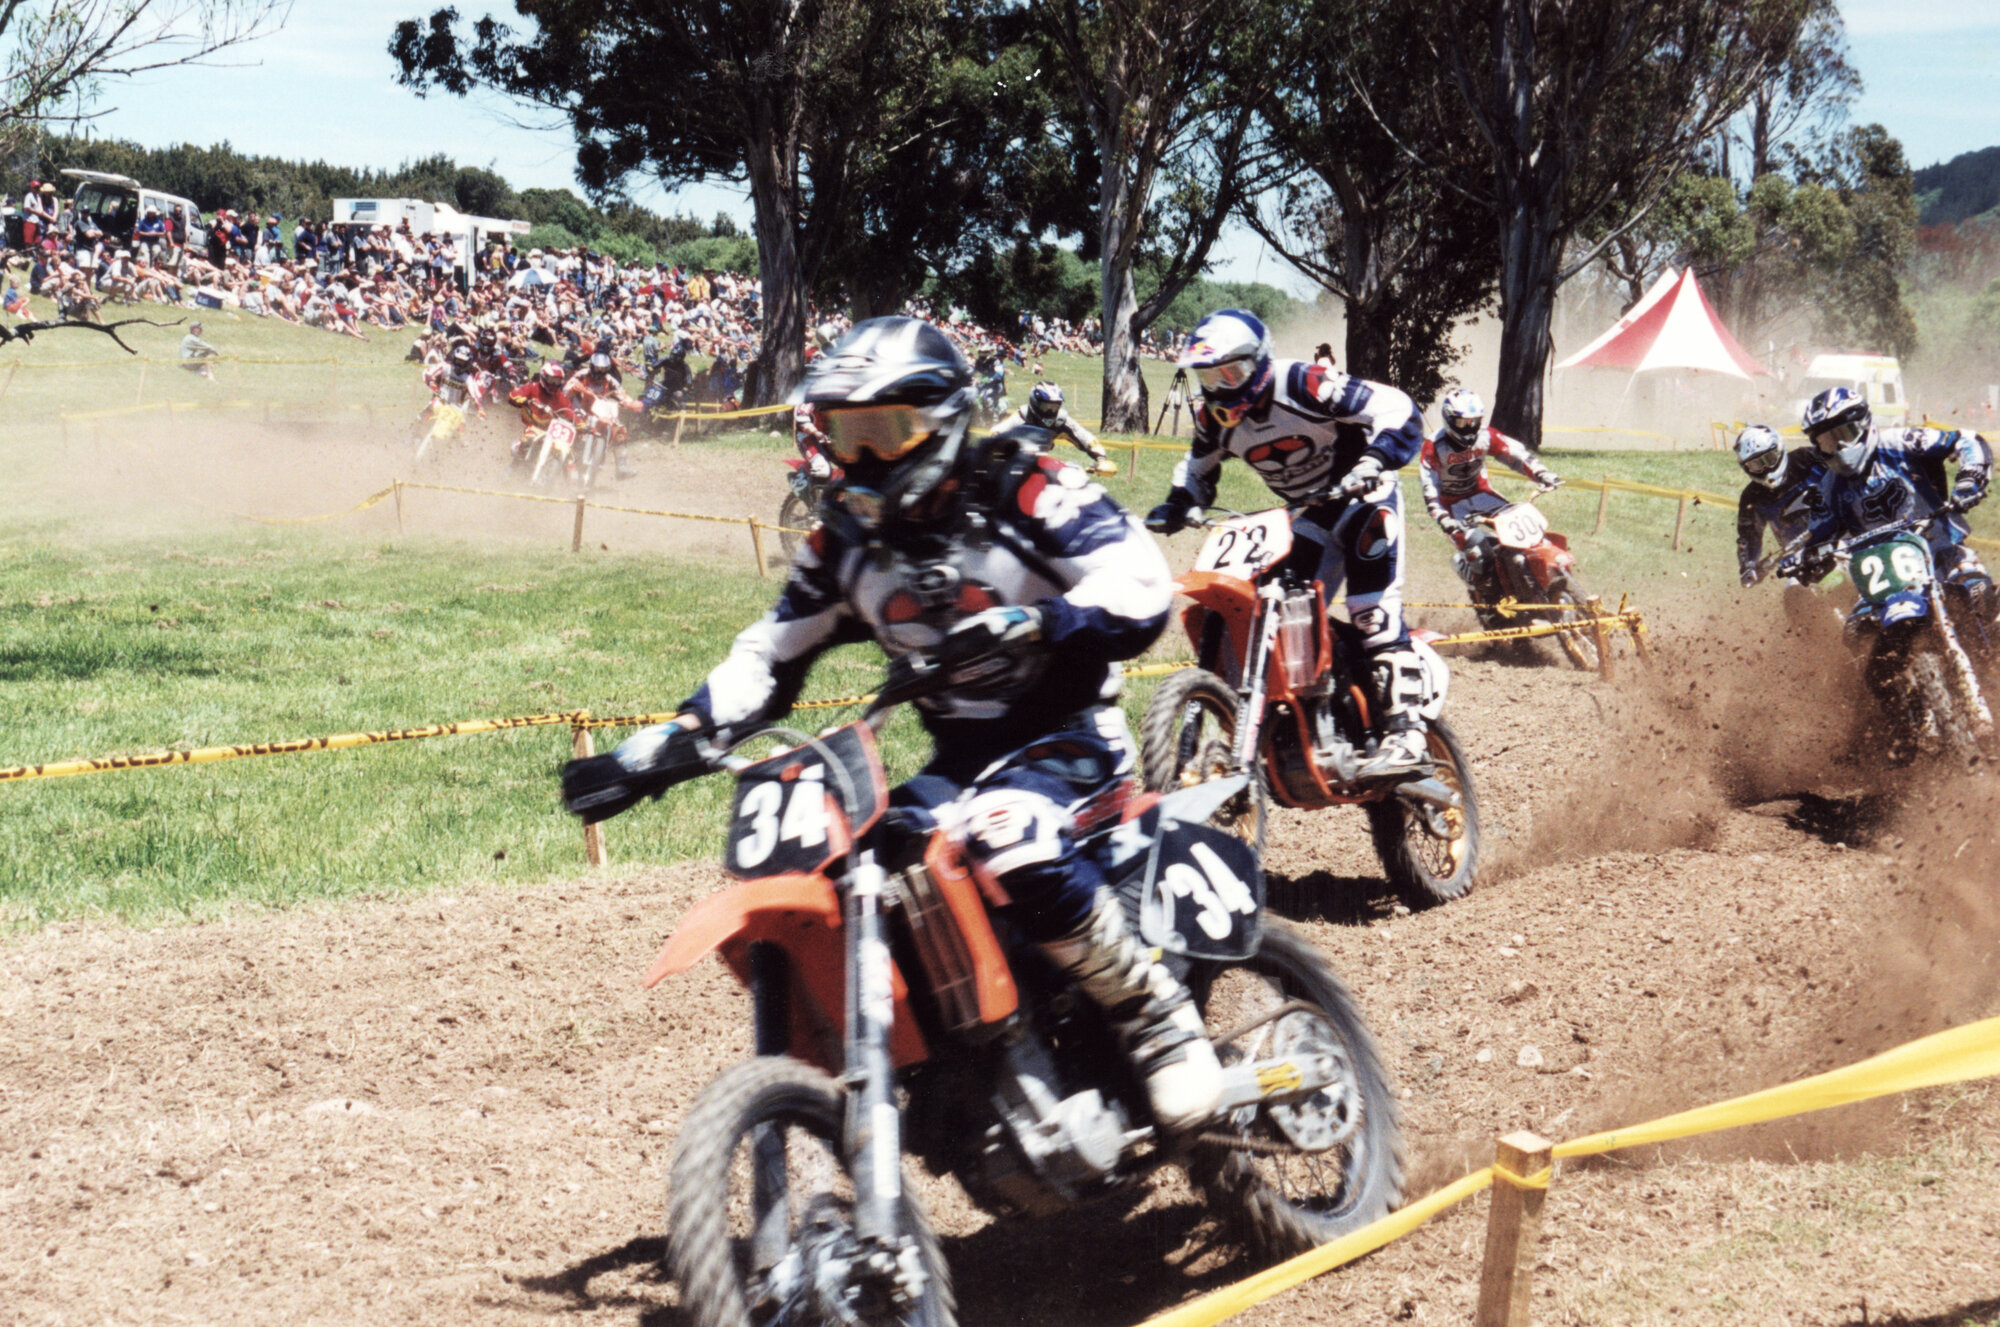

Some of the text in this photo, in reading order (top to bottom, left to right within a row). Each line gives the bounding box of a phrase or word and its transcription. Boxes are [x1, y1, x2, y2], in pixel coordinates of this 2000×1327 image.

[1213, 525, 1267, 570] 22
[1509, 515, 1539, 542] 30
[1860, 546, 1923, 596] 26
[736, 763, 832, 869] 34
[1165, 841, 1257, 940] 34
